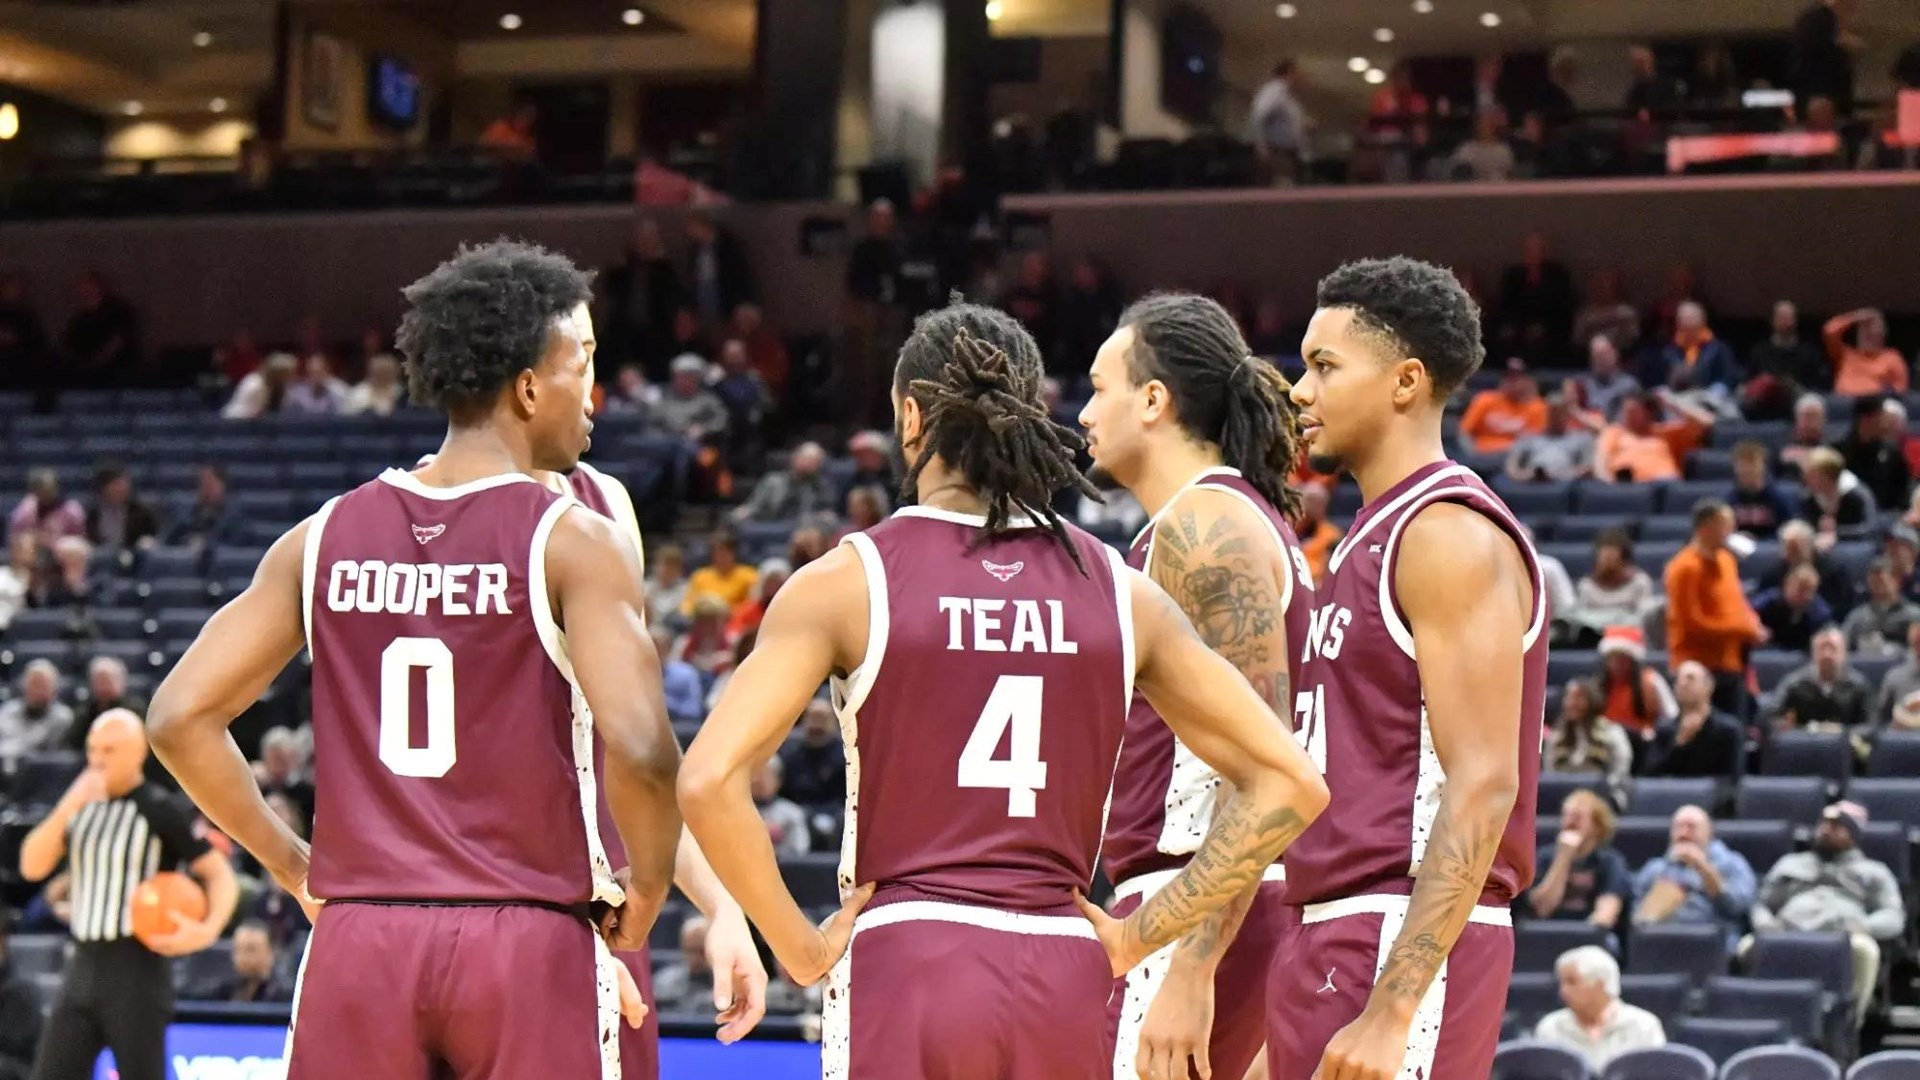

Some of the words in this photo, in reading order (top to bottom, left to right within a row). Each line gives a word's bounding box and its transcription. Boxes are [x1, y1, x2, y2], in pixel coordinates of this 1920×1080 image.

[327, 560, 513, 616] COOPER
[939, 596, 1078, 654] TEAL
[379, 636, 457, 778] 0
[957, 674, 1047, 818] 4
